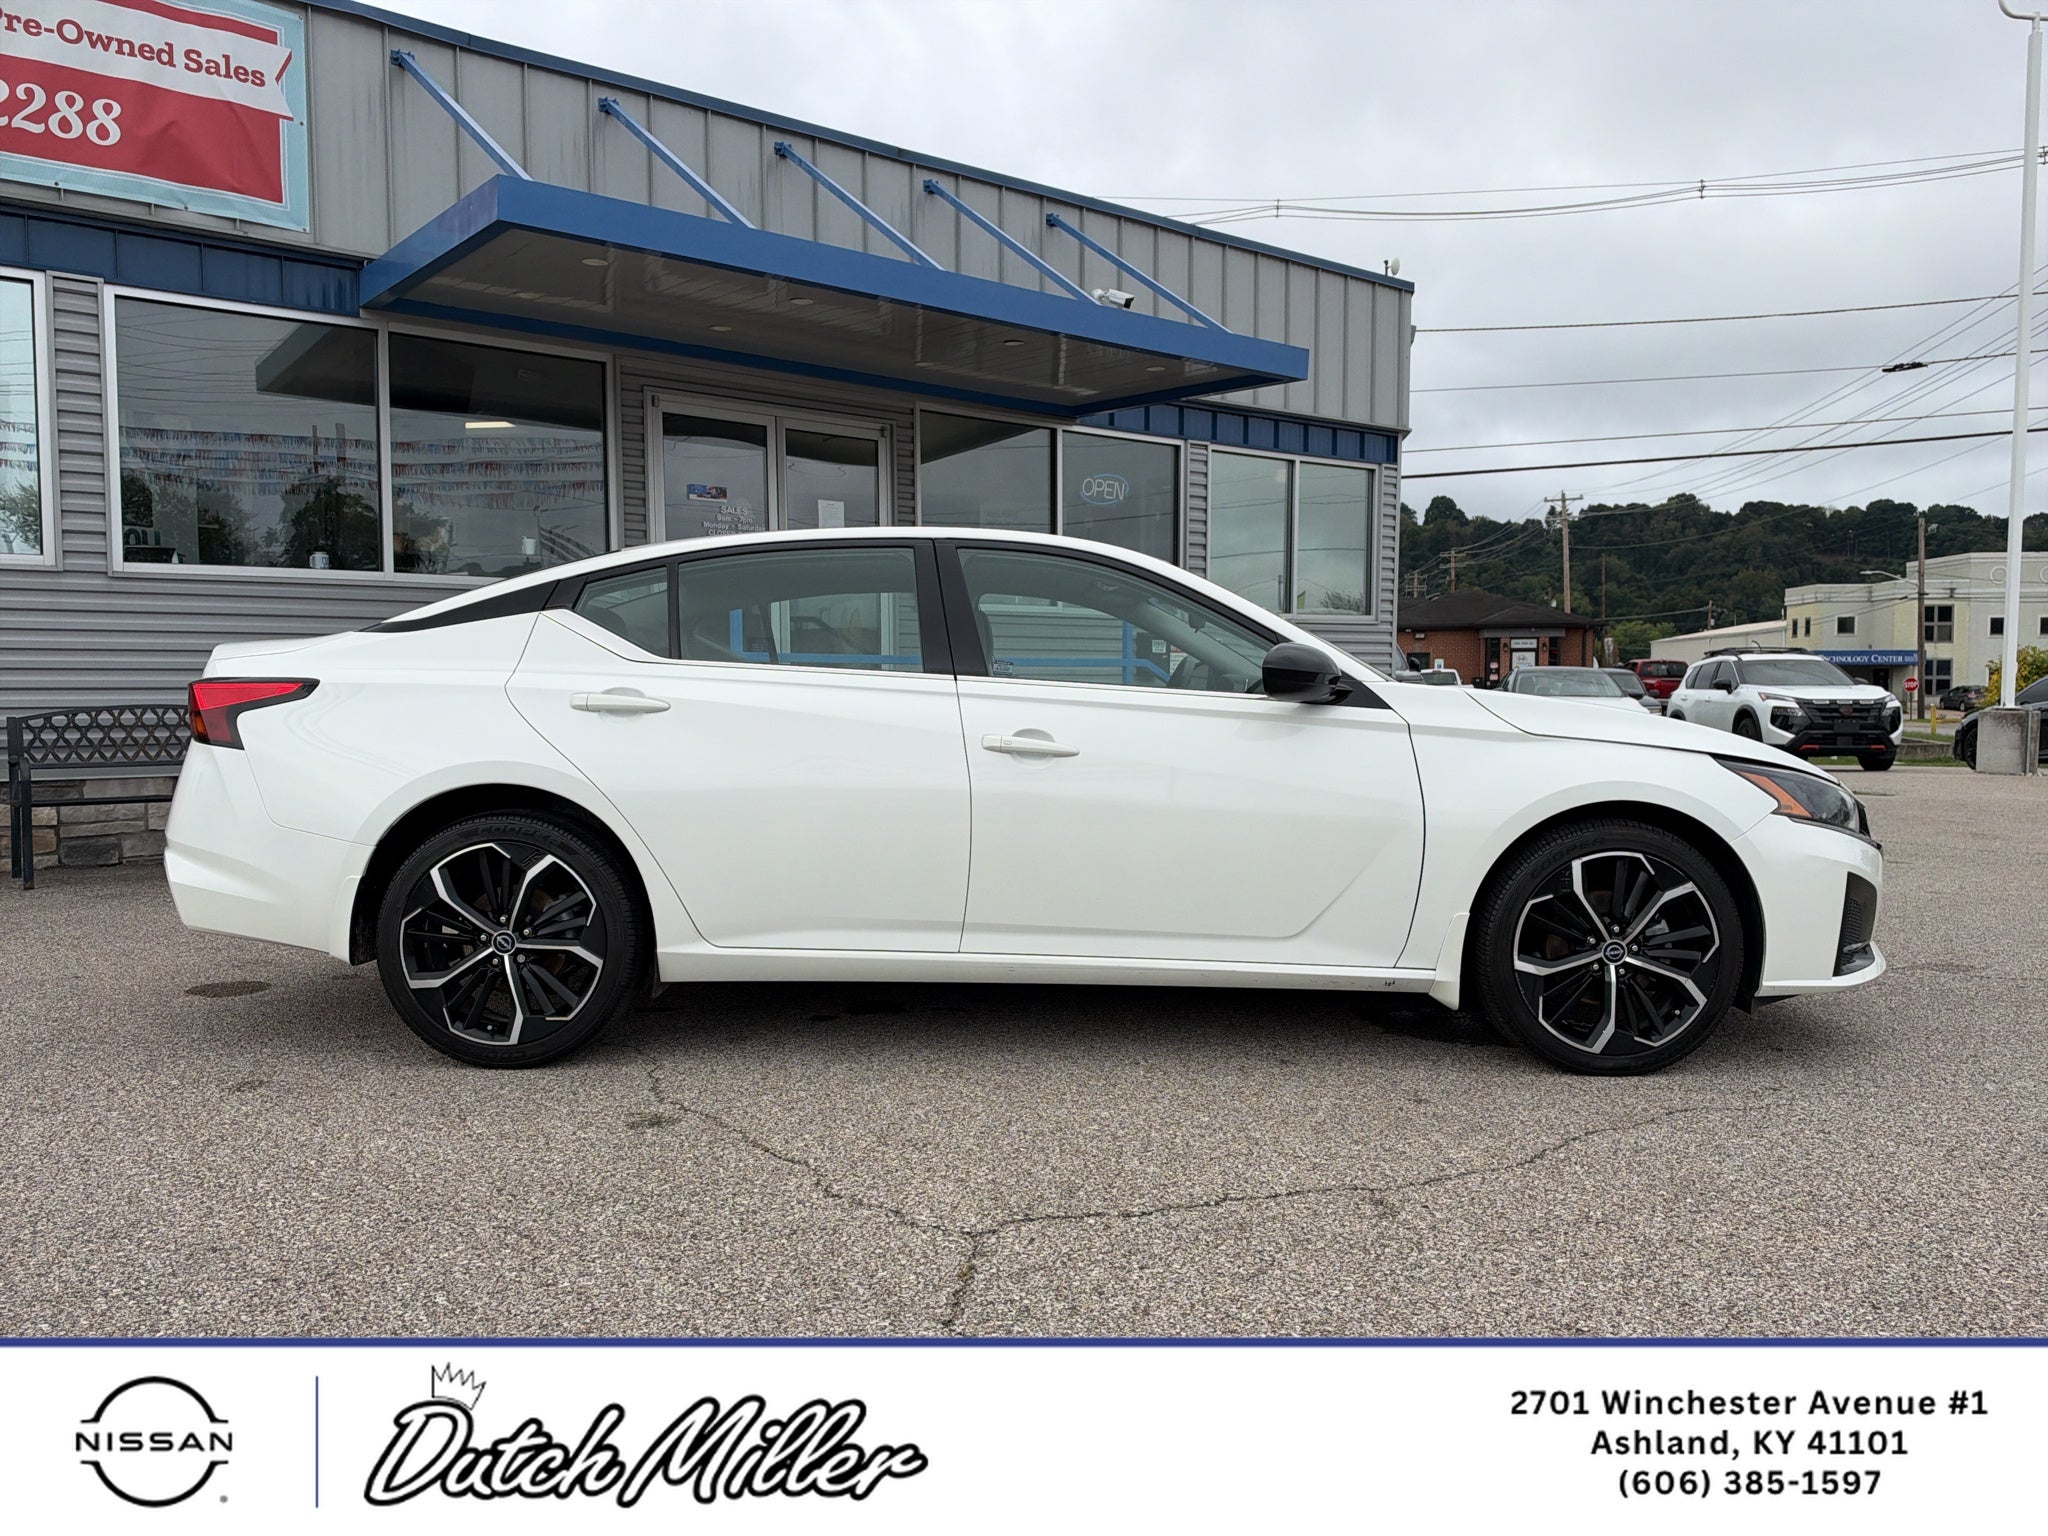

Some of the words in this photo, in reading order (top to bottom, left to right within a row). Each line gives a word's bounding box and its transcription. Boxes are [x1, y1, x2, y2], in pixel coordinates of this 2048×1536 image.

[0, 6, 176, 68] re-Owned
[184, 49, 266, 87] Sales
[1082, 478, 1125, 500] OPEN
[720, 505, 748, 515] SALES
[703, 521, 729, 530] Monday
[1870, 654, 1903, 663] CENTER
[1904, 681, 1918, 689] STOP
